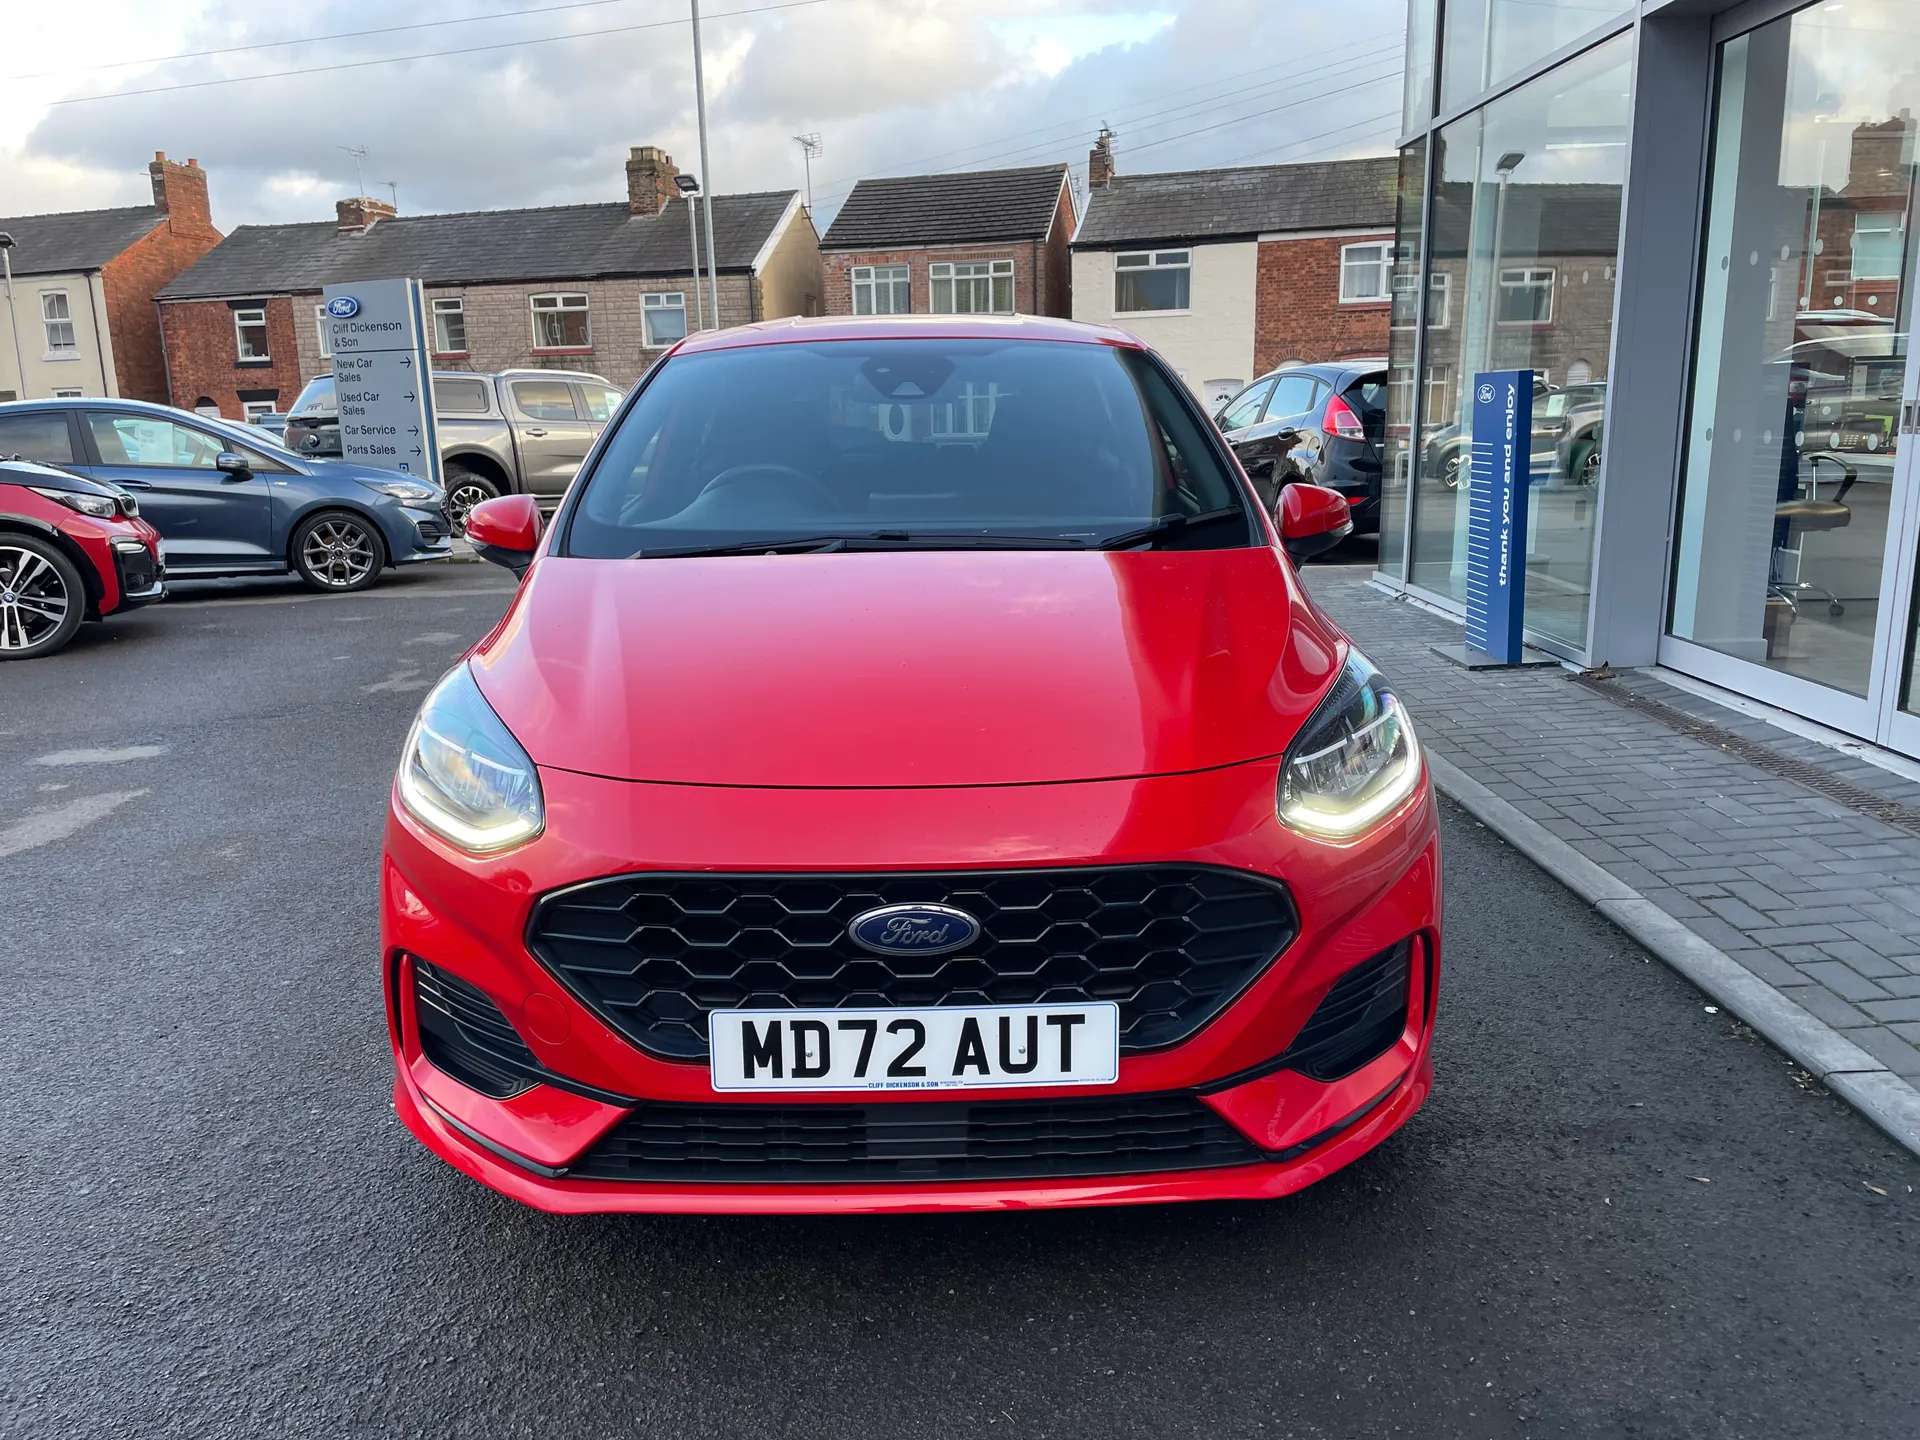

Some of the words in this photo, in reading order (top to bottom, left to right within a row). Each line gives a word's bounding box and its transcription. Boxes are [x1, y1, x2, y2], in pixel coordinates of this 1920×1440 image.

[333, 323, 349, 334] Cliff
[351, 322, 402, 333] Dickenson
[334, 338, 340, 347] &
[342, 337, 359, 347] Son
[337, 360, 355, 369] New
[357, 358, 373, 368] Car
[339, 373, 362, 382] Sales
[341, 393, 361, 402] Used
[363, 391, 380, 401] Car
[342, 405, 366, 415] Sales
[1505, 384, 1515, 440] enjoy
[345, 425, 359, 435] Car
[361, 425, 396, 435] Service
[347, 445, 369, 455] Parts
[370, 445, 396, 455] Sales
[1504, 444, 1512, 484] and
[1502, 488, 1510, 525] you
[1499, 528, 1508, 586] thank
[880, 917, 950, 945] Ford
[742, 1019, 927, 1079] MD72
[952, 1014, 1086, 1076] AUT
